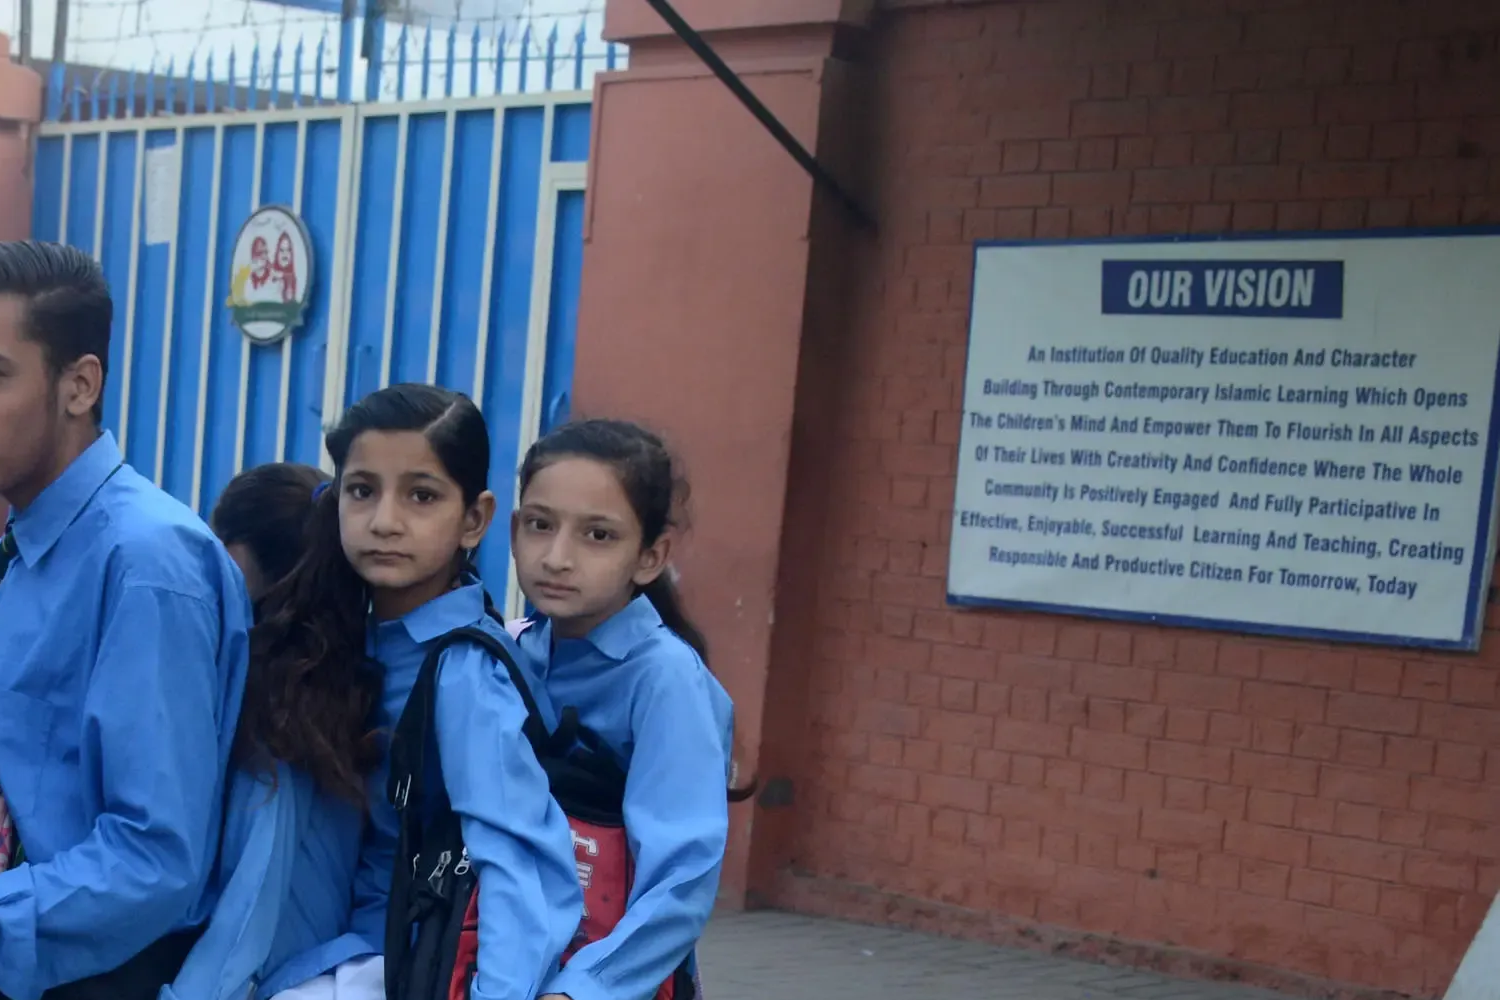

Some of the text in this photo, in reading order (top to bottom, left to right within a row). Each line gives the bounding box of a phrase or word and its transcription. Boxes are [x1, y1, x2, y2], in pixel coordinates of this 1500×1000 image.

[1127, 269, 1315, 307] OUR VISION
[1027, 346, 1417, 368] An Institution Of Quality Education And Character
[983, 379, 1468, 410] Building Through Contemporary Islamic Learning Which Opens
[970, 412, 1479, 449] The Children's Mind And Empower Them To Flourish In All Aspects
[975, 445, 1463, 485] Of Their Lives With Creativity And Confidence Where The Whole
[985, 478, 1440, 522] Community Is Positively Engaged And Fully Participative In
[960, 511, 1465, 565] Effective, Enjoyable, Successful Learning And Teaching, Creating
[989, 546, 1418, 600] Responsible And Productive Citizen For Tomorrow, Today
